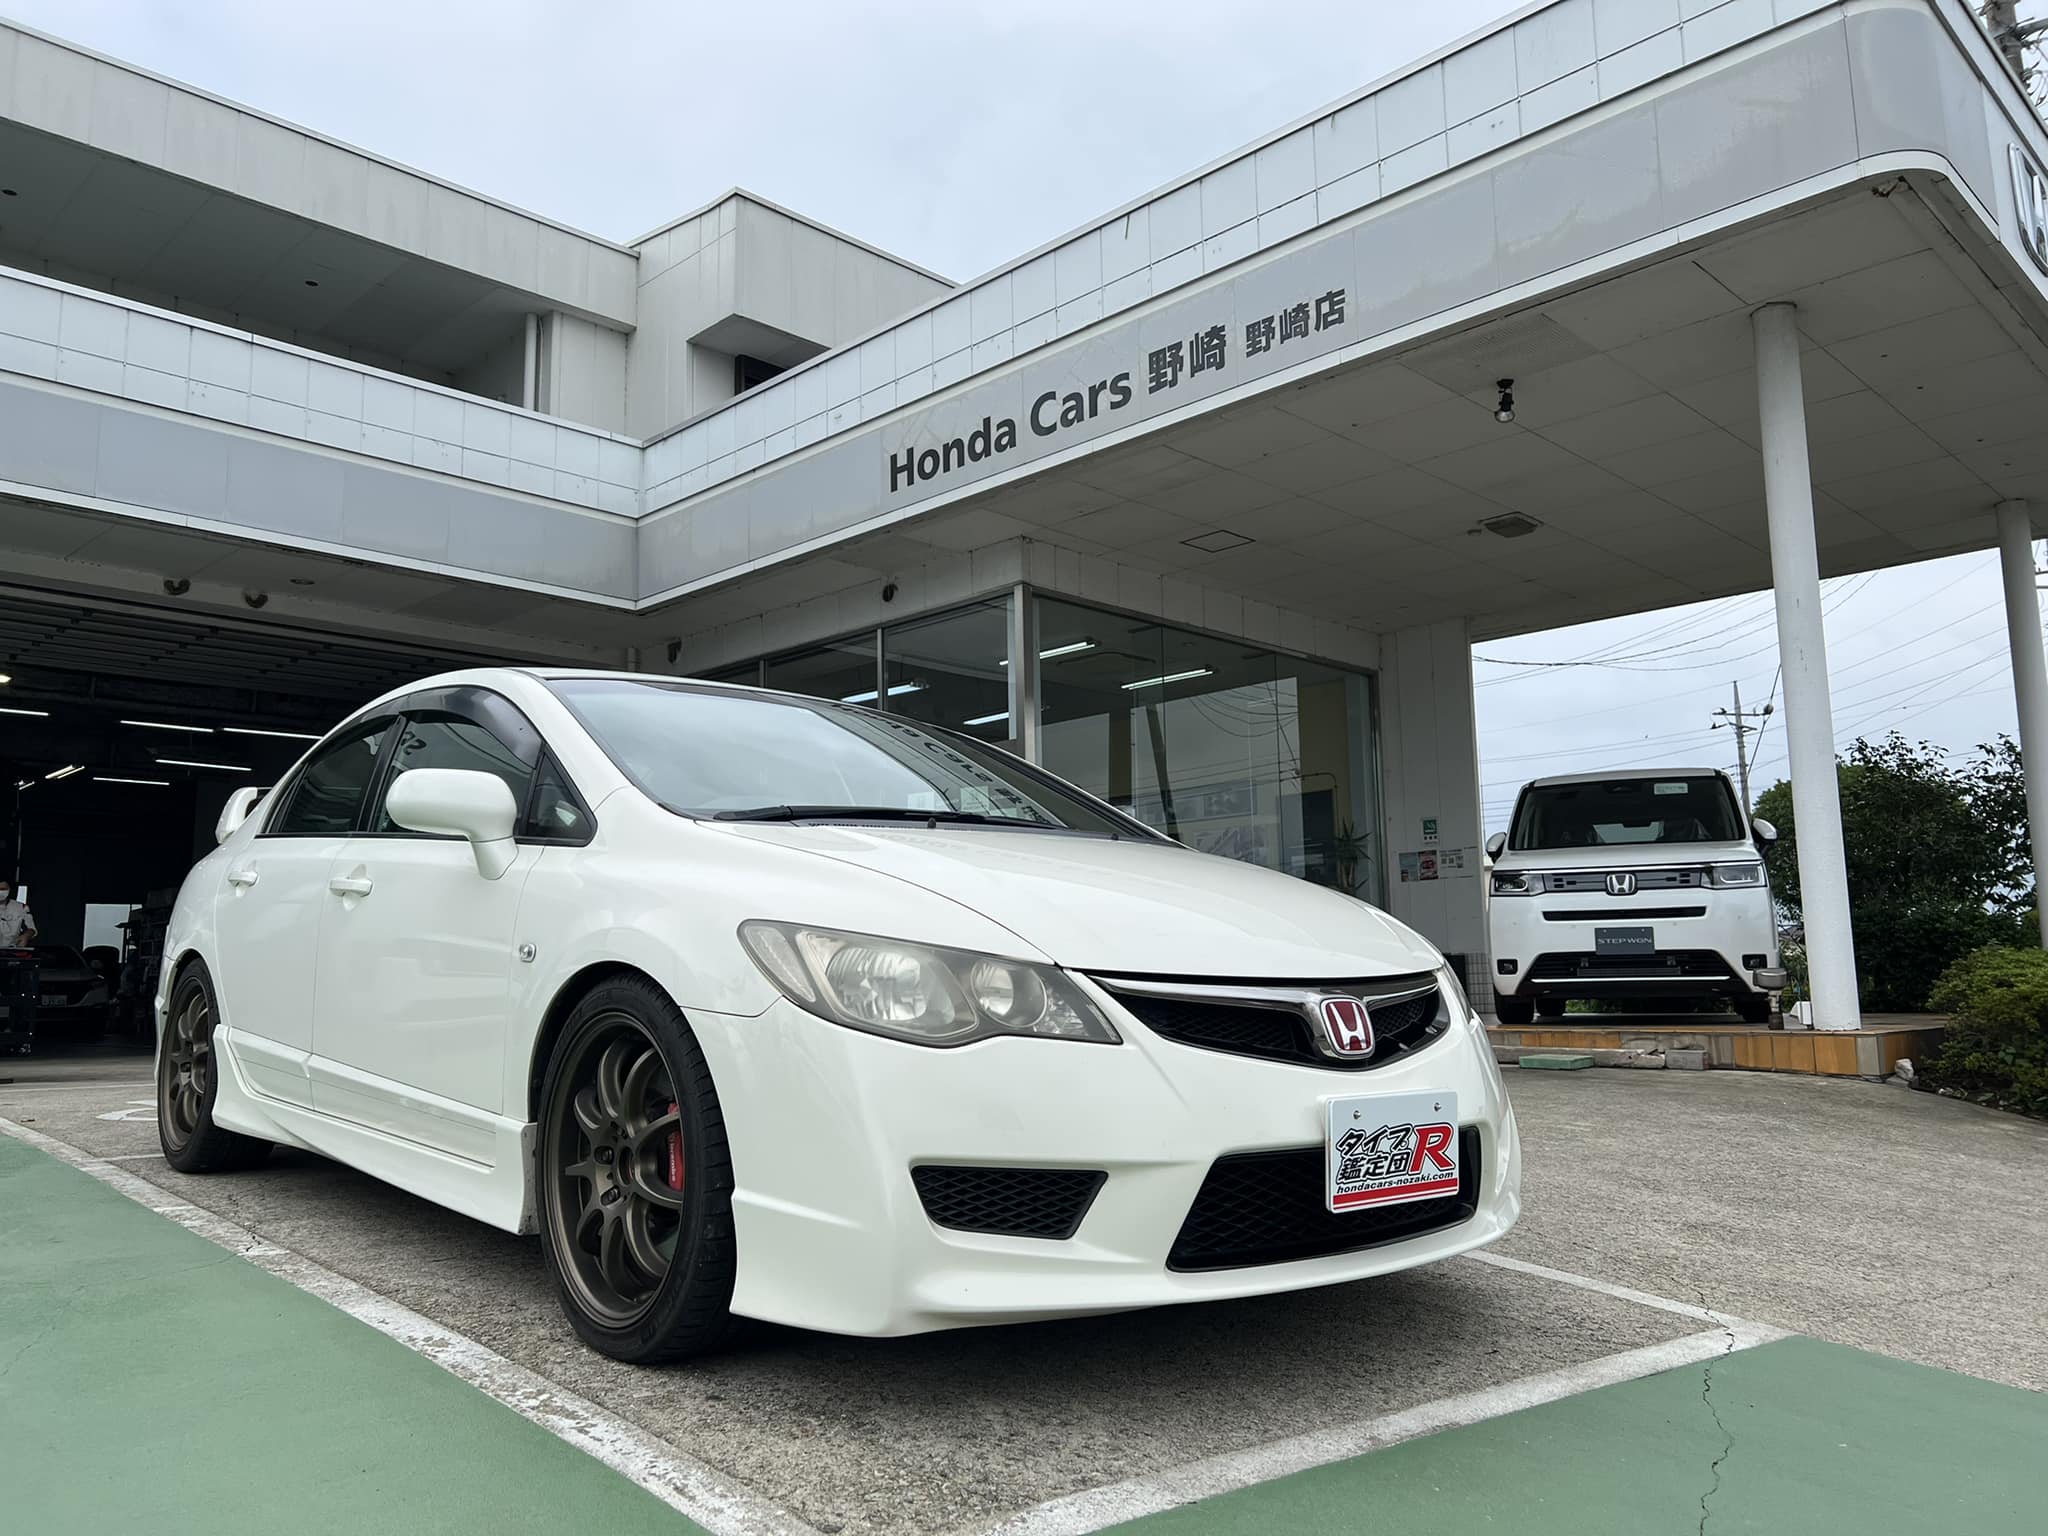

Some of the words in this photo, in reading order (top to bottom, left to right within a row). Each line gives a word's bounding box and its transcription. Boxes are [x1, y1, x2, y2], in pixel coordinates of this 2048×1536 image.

[890, 416, 1017, 493] Honda
[1029, 371, 1133, 437] Cars
[1147, 324, 1227, 395] 野崎
[1245, 288, 1347, 359] 野崎店
[1337, 1126, 1412, 1157] タイプ
[1408, 1122, 1456, 1176] R
[1336, 1171, 1454, 1194] hondacars-nozaki.com
[1337, 1152, 1411, 1182] 鑑定団
